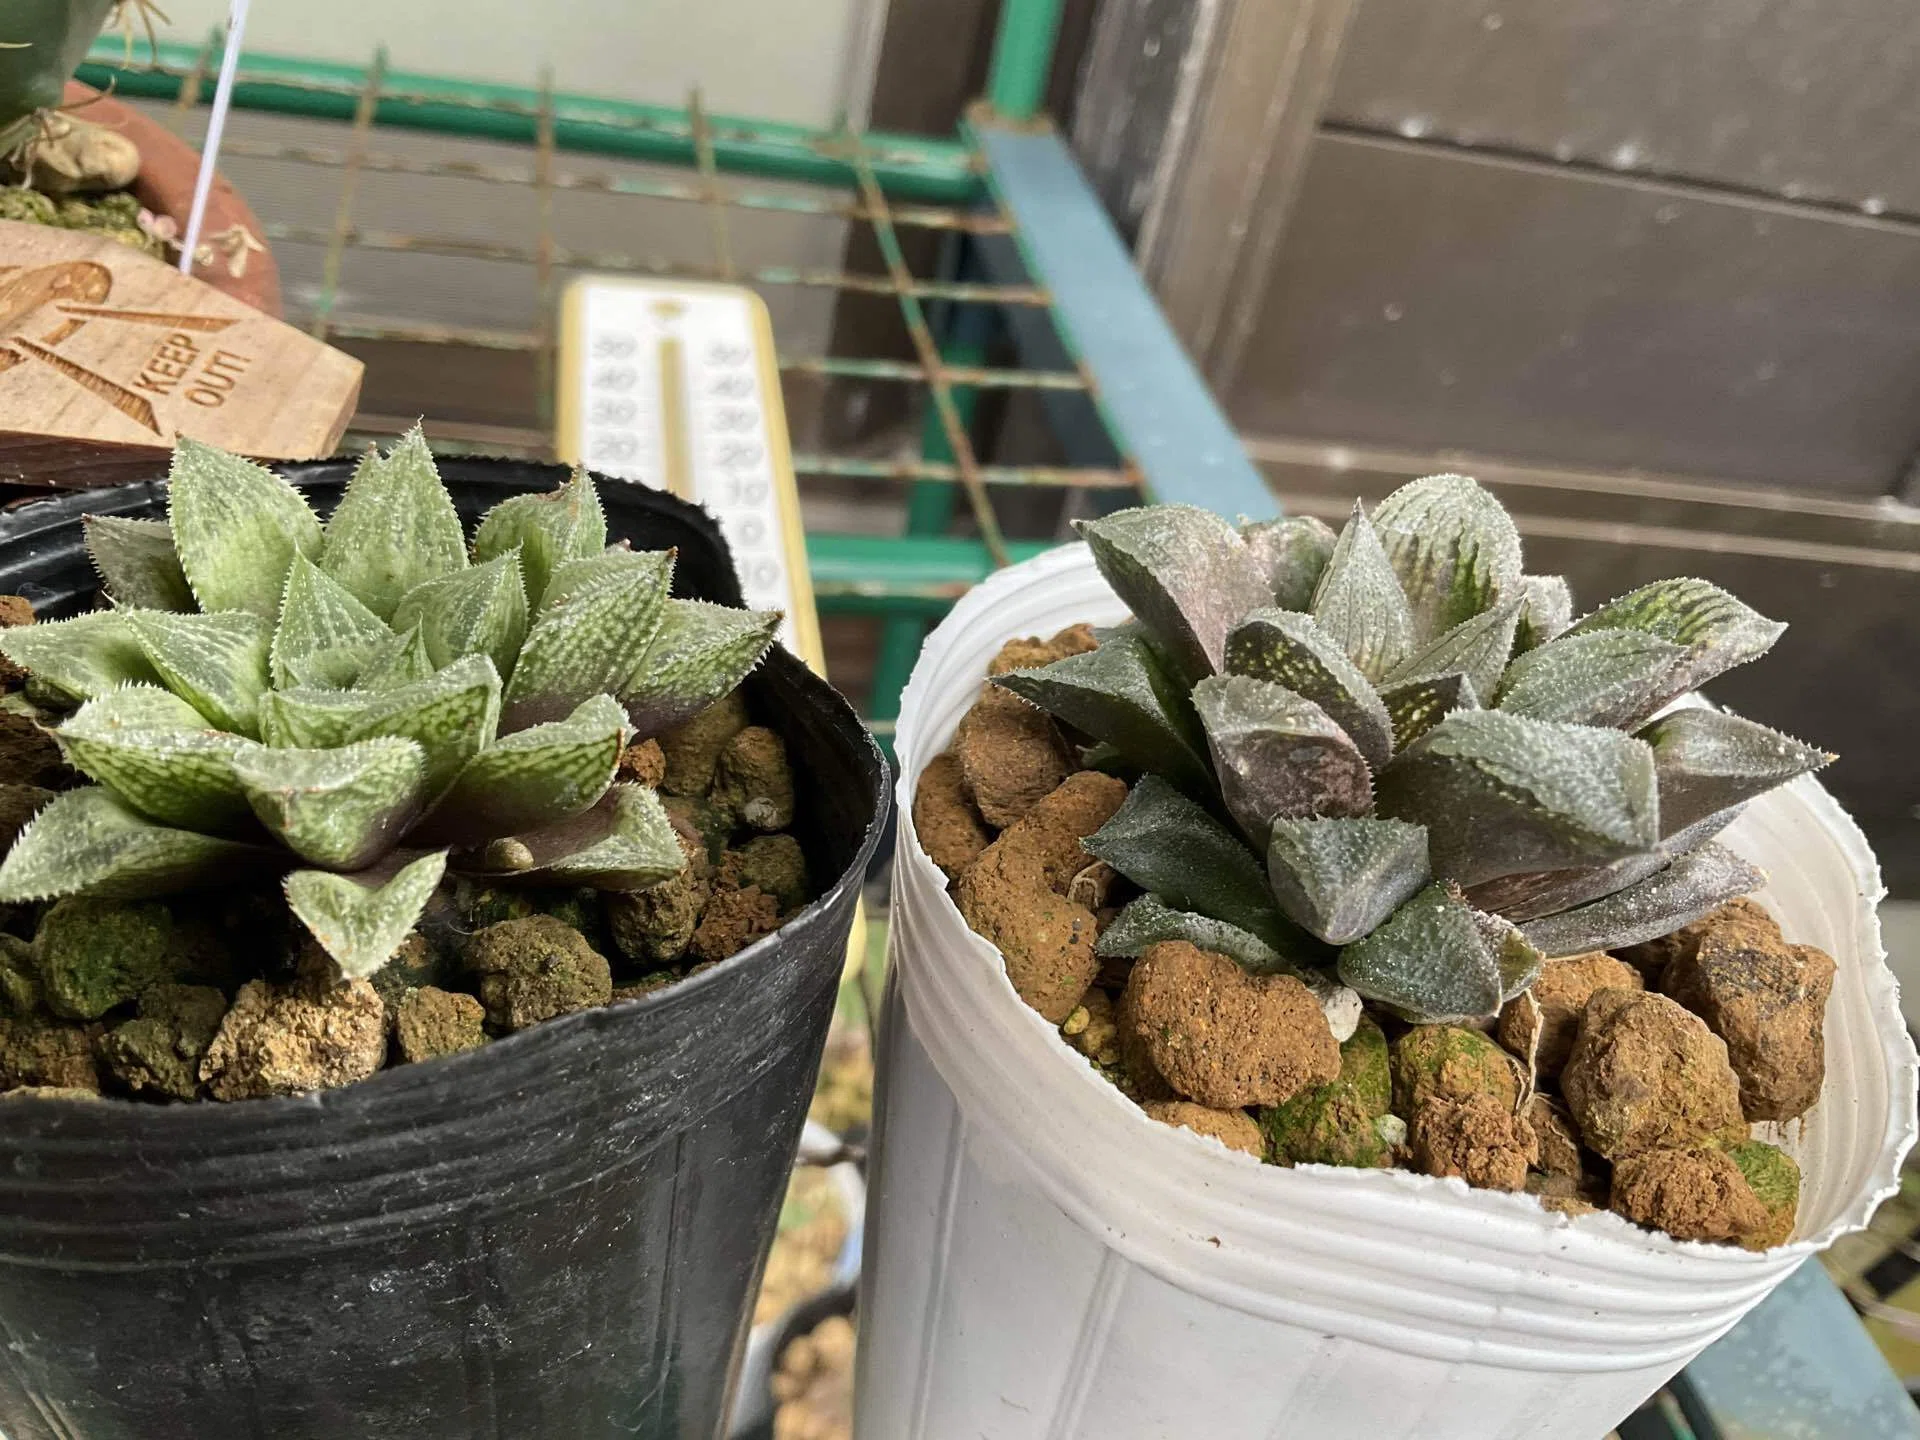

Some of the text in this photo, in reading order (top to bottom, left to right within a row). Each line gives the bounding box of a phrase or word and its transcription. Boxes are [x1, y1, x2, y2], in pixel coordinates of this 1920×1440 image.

[133, 333, 200, 395] KEEP
[184, 350, 252, 407] OUT!
[713, 444, 764, 471] 20
[728, 478, 770, 507] 10
[736, 517, 767, 548] 0
